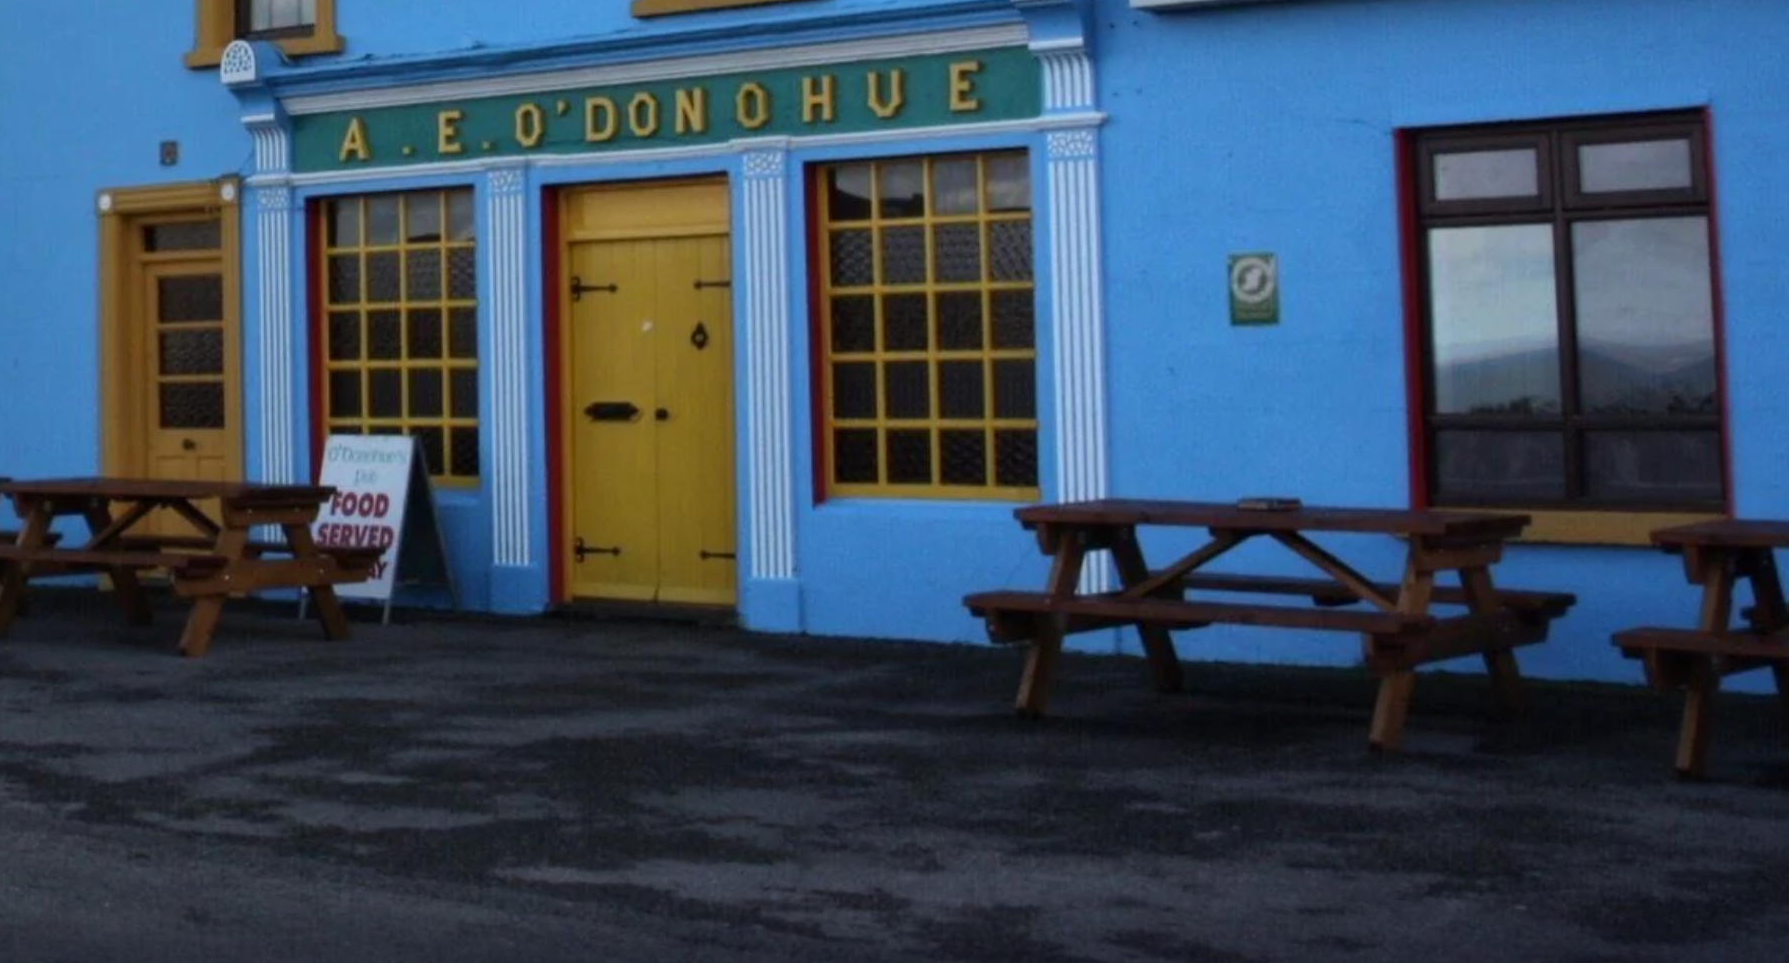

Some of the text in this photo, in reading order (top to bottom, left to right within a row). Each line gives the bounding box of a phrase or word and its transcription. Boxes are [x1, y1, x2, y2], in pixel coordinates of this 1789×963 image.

[514, 61, 981, 148] O'DONOHUE
[330, 492, 390, 518] FOOD
[315, 523, 394, 550] SERVED
